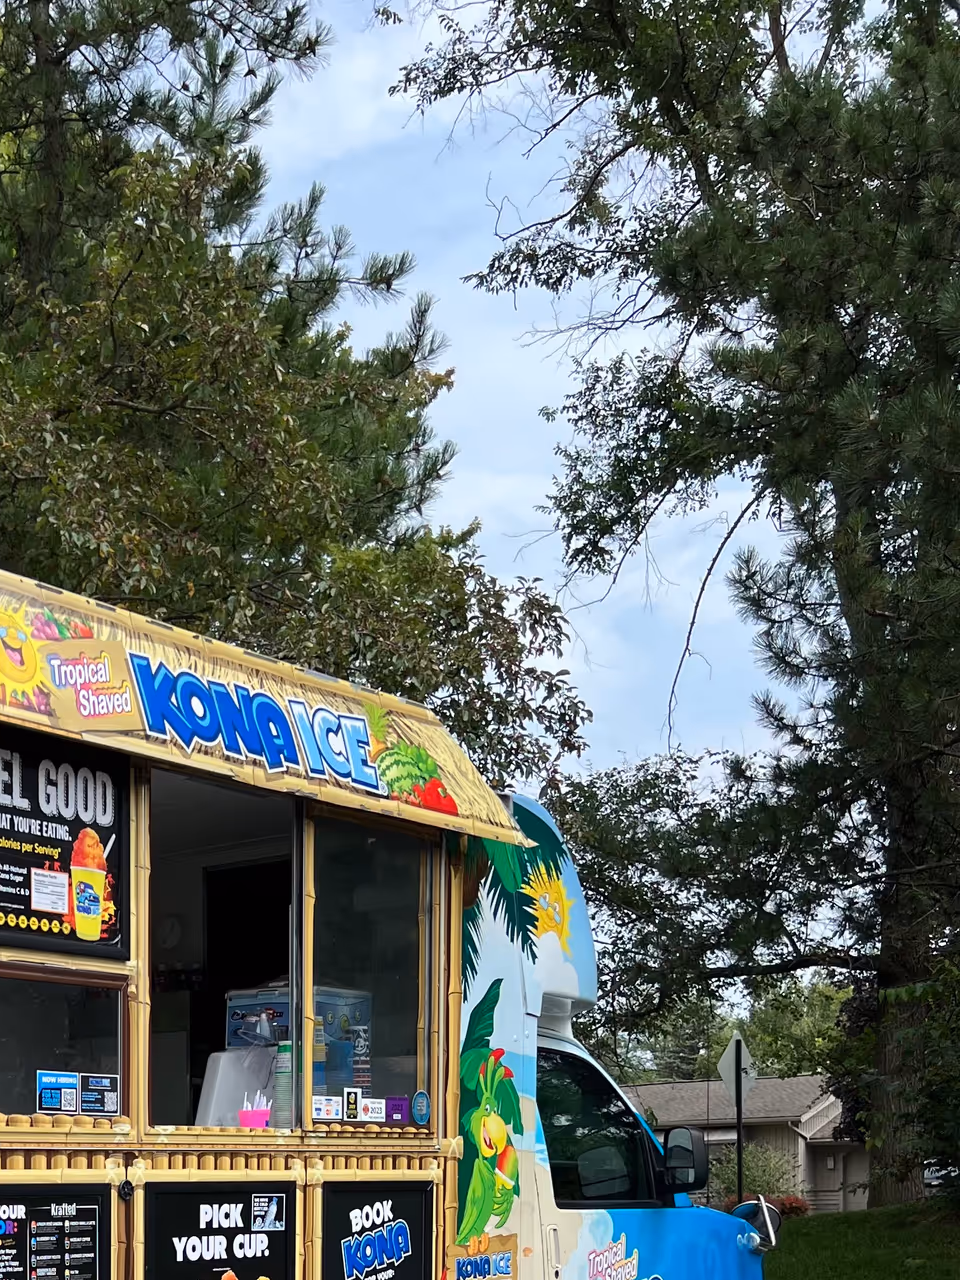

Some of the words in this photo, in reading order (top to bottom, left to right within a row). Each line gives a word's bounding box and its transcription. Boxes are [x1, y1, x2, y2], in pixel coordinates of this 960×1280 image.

[50, 651, 111, 689] Tropical
[78, 683, 132, 717] Shaved
[128, 651, 300, 772] KONA
[288, 700, 382, 796] ICE
[38, 759, 115, 827] GOOD
[13, 815, 41, 836] YOU'RE
[42, 822, 73, 841] EATING.
[22, 842, 33, 853] per
[10, 874, 23, 883] Sugar
[370, 1106, 383, 1114] 2023
[50, 1203, 77, 1216] Krafted
[199, 1203, 244, 1229] PICK
[349, 1199, 394, 1233] BOOK
[172, 1235, 227, 1262] YOUR
[232, 1233, 270, 1259] CUP.
[589, 1233, 626, 1280] Tropical
[491, 1251, 512, 1276] ICE
